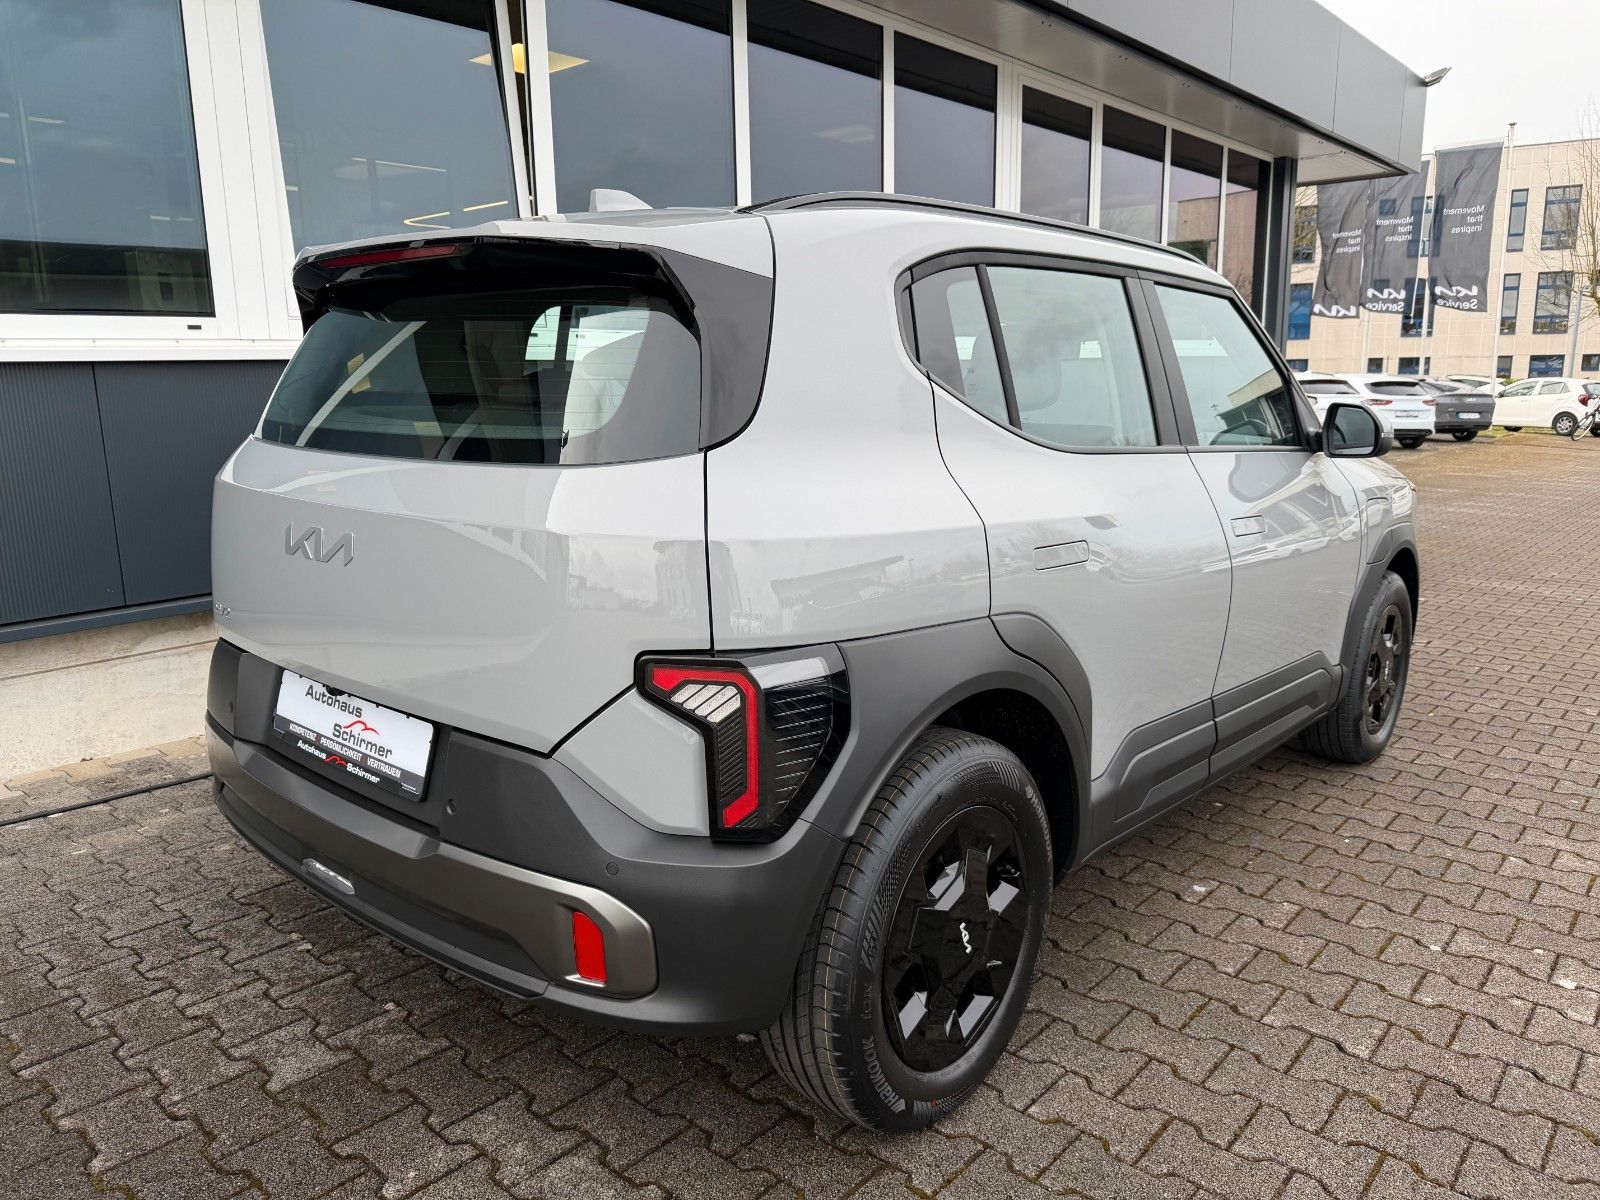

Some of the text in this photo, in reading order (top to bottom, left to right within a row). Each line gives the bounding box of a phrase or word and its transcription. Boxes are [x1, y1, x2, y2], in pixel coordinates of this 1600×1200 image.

[284, 520, 355, 567] KIA
[304, 684, 363, 718] Autohaus
[289, 722, 317, 741] KOMPETENZ
[367, 756, 401, 778] VERTRAUEN
[297, 739, 380, 783] Autohaus Schirmer
[332, 722, 393, 759] Schirmer
